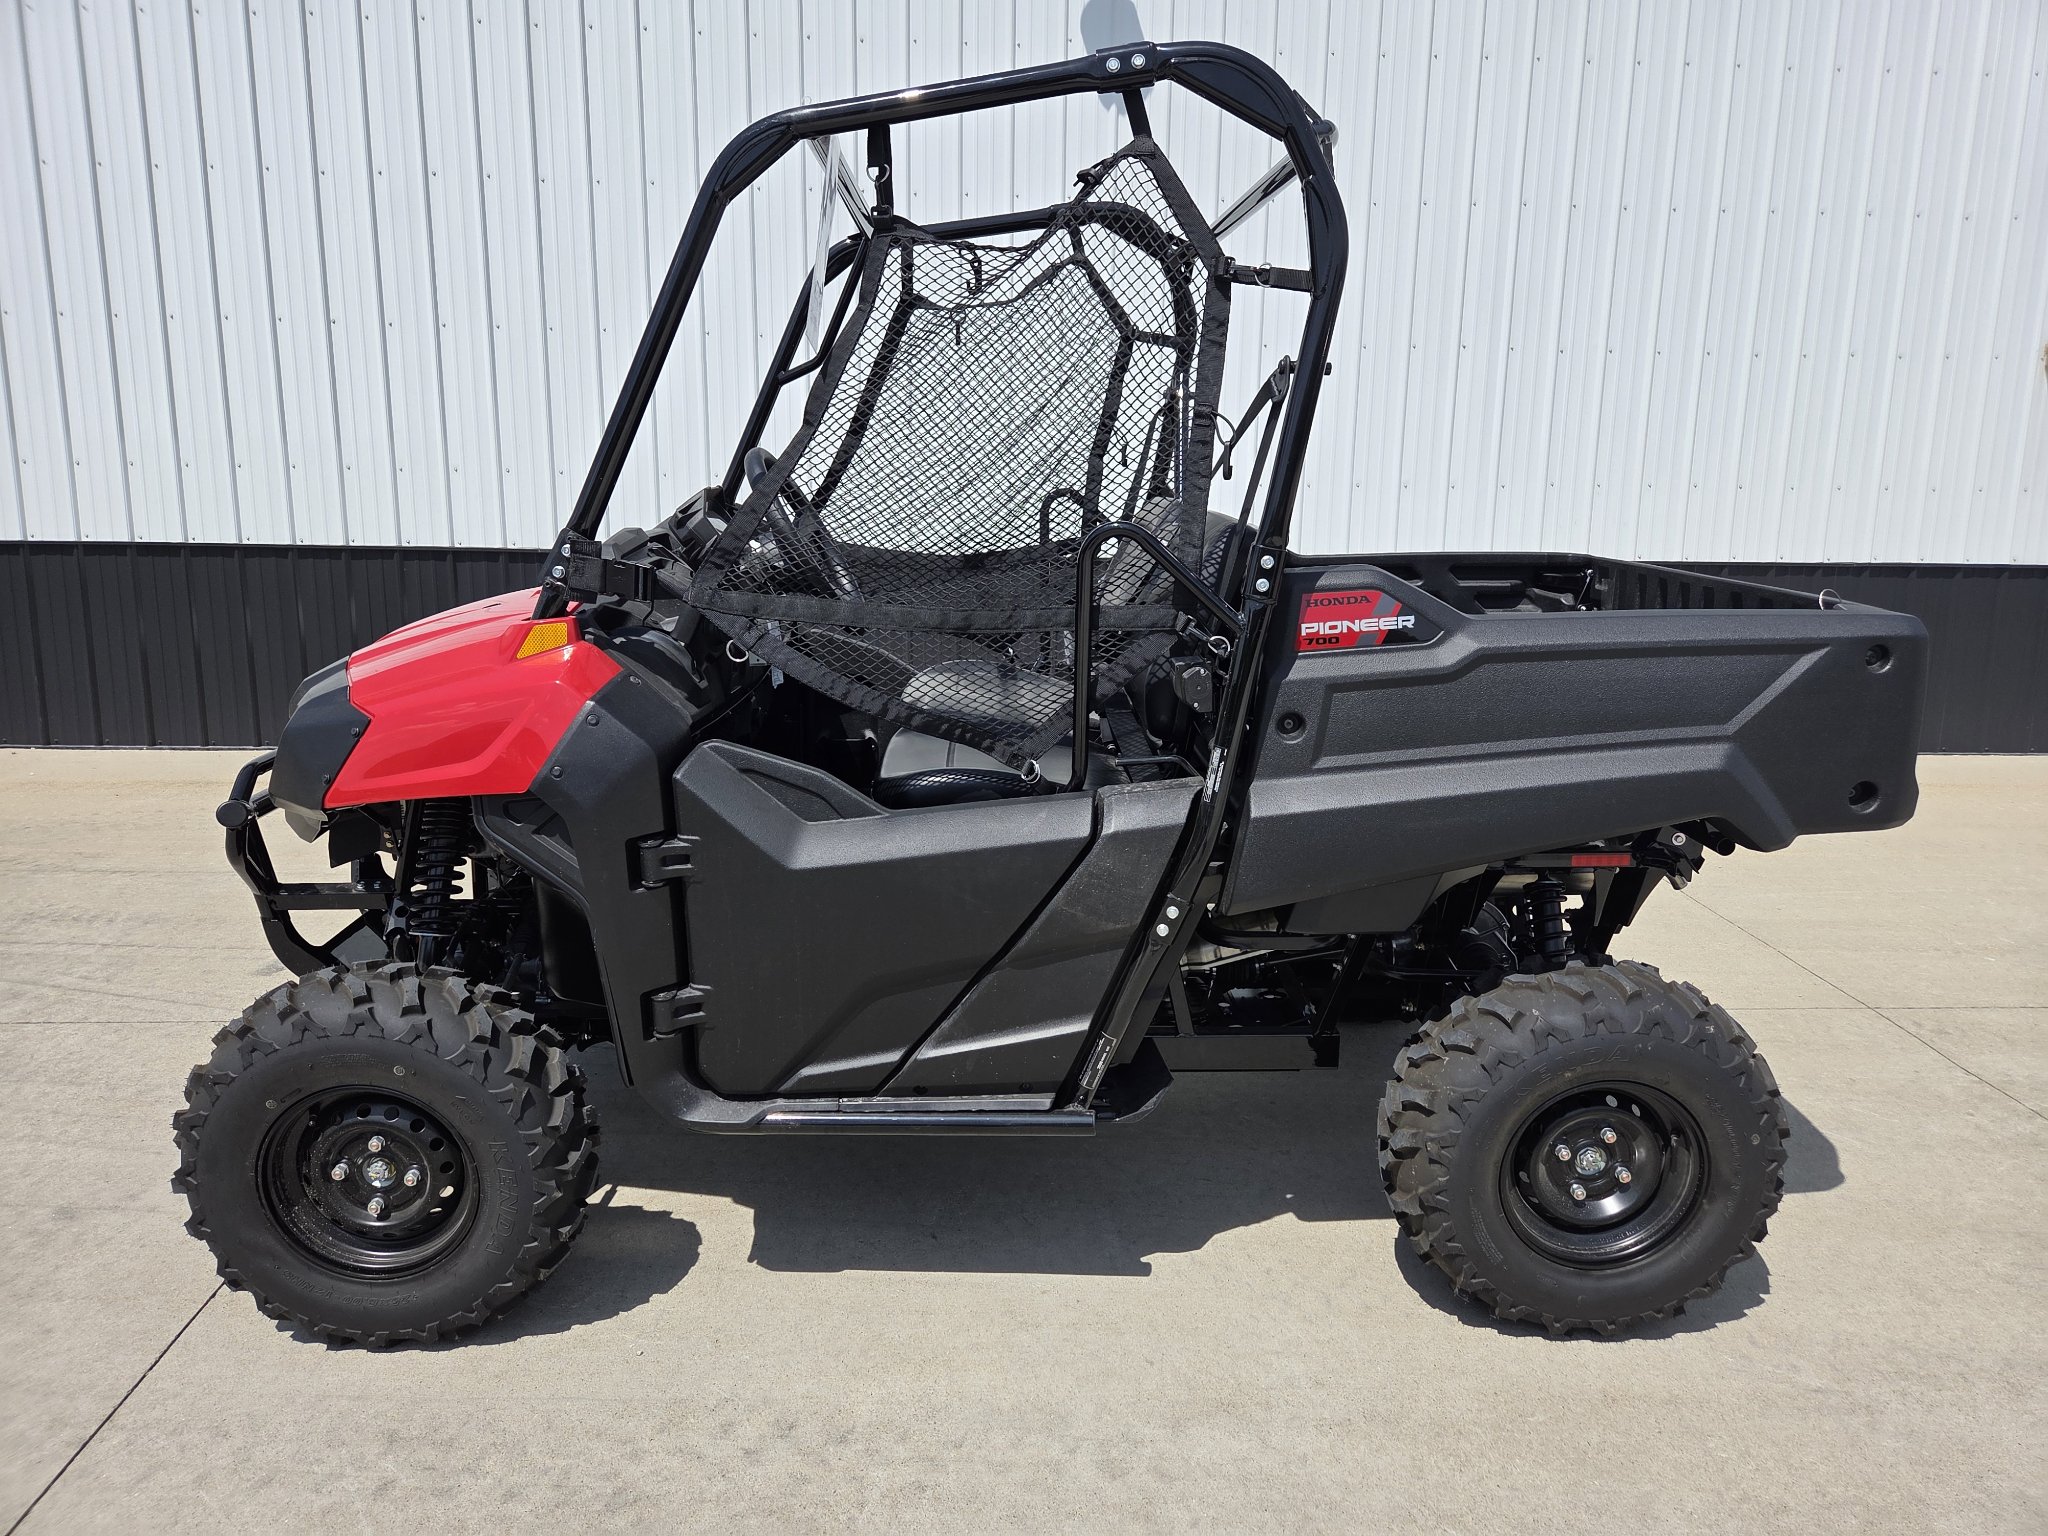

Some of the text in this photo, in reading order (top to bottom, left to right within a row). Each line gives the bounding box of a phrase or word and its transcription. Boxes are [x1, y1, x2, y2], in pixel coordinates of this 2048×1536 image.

[1305, 595, 1371, 607] HONDA
[1300, 615, 1415, 635] PIONEER
[1303, 636, 1340, 645] 700
[1503, 1044, 1630, 1105] KENDA
[484, 1136, 519, 1255] KENDA
